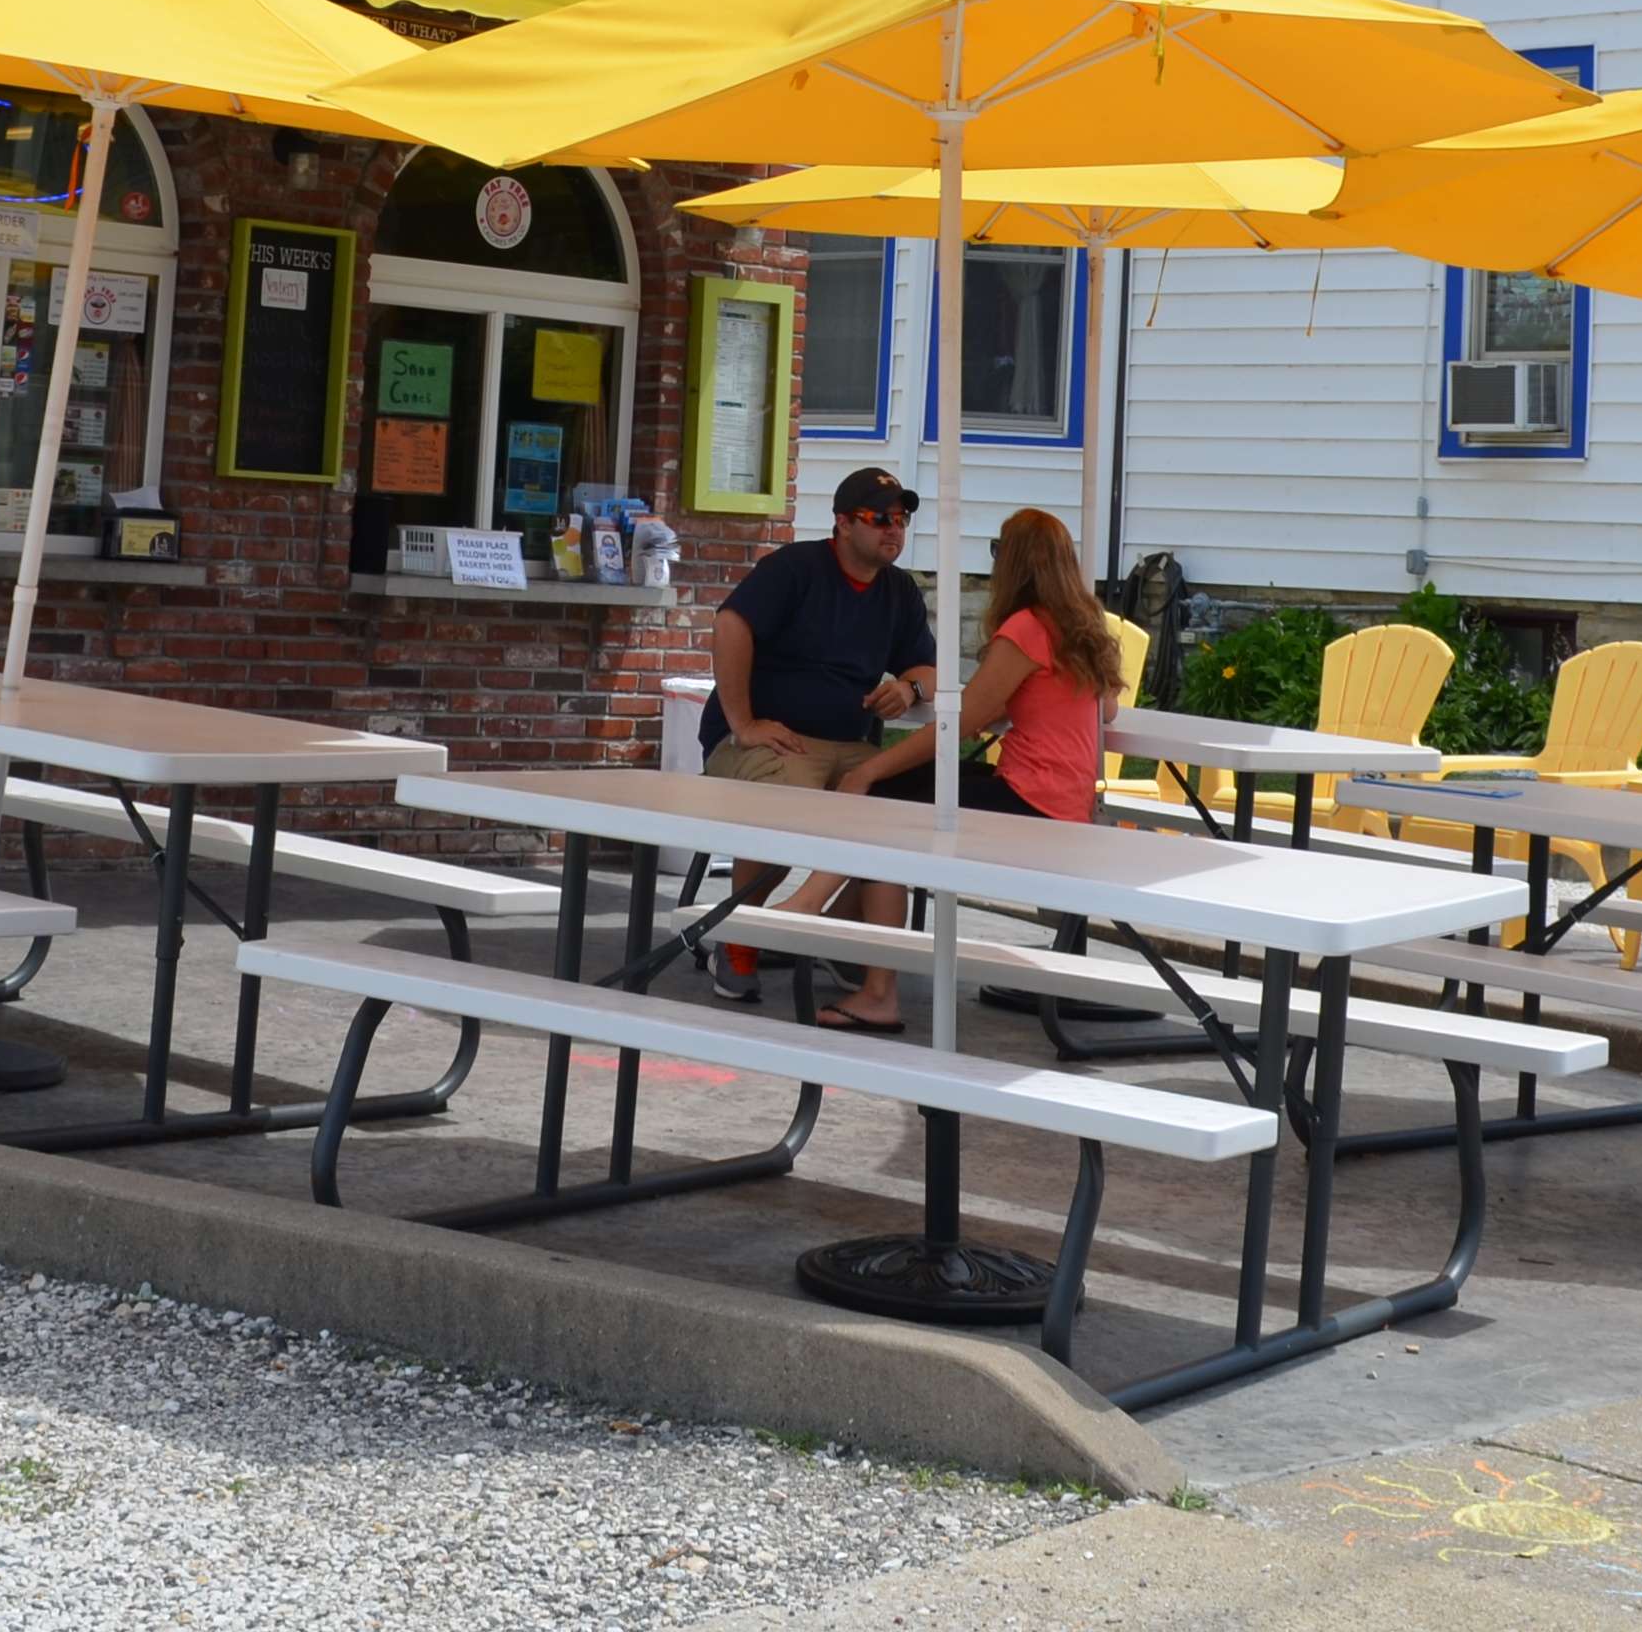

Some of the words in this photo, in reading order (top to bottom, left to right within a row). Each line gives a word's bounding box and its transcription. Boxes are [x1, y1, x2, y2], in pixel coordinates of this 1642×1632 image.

[484, 179, 502, 196] FAT
[250, 243, 274, 265] HIS
[279, 246, 332, 271] WEEK'S
